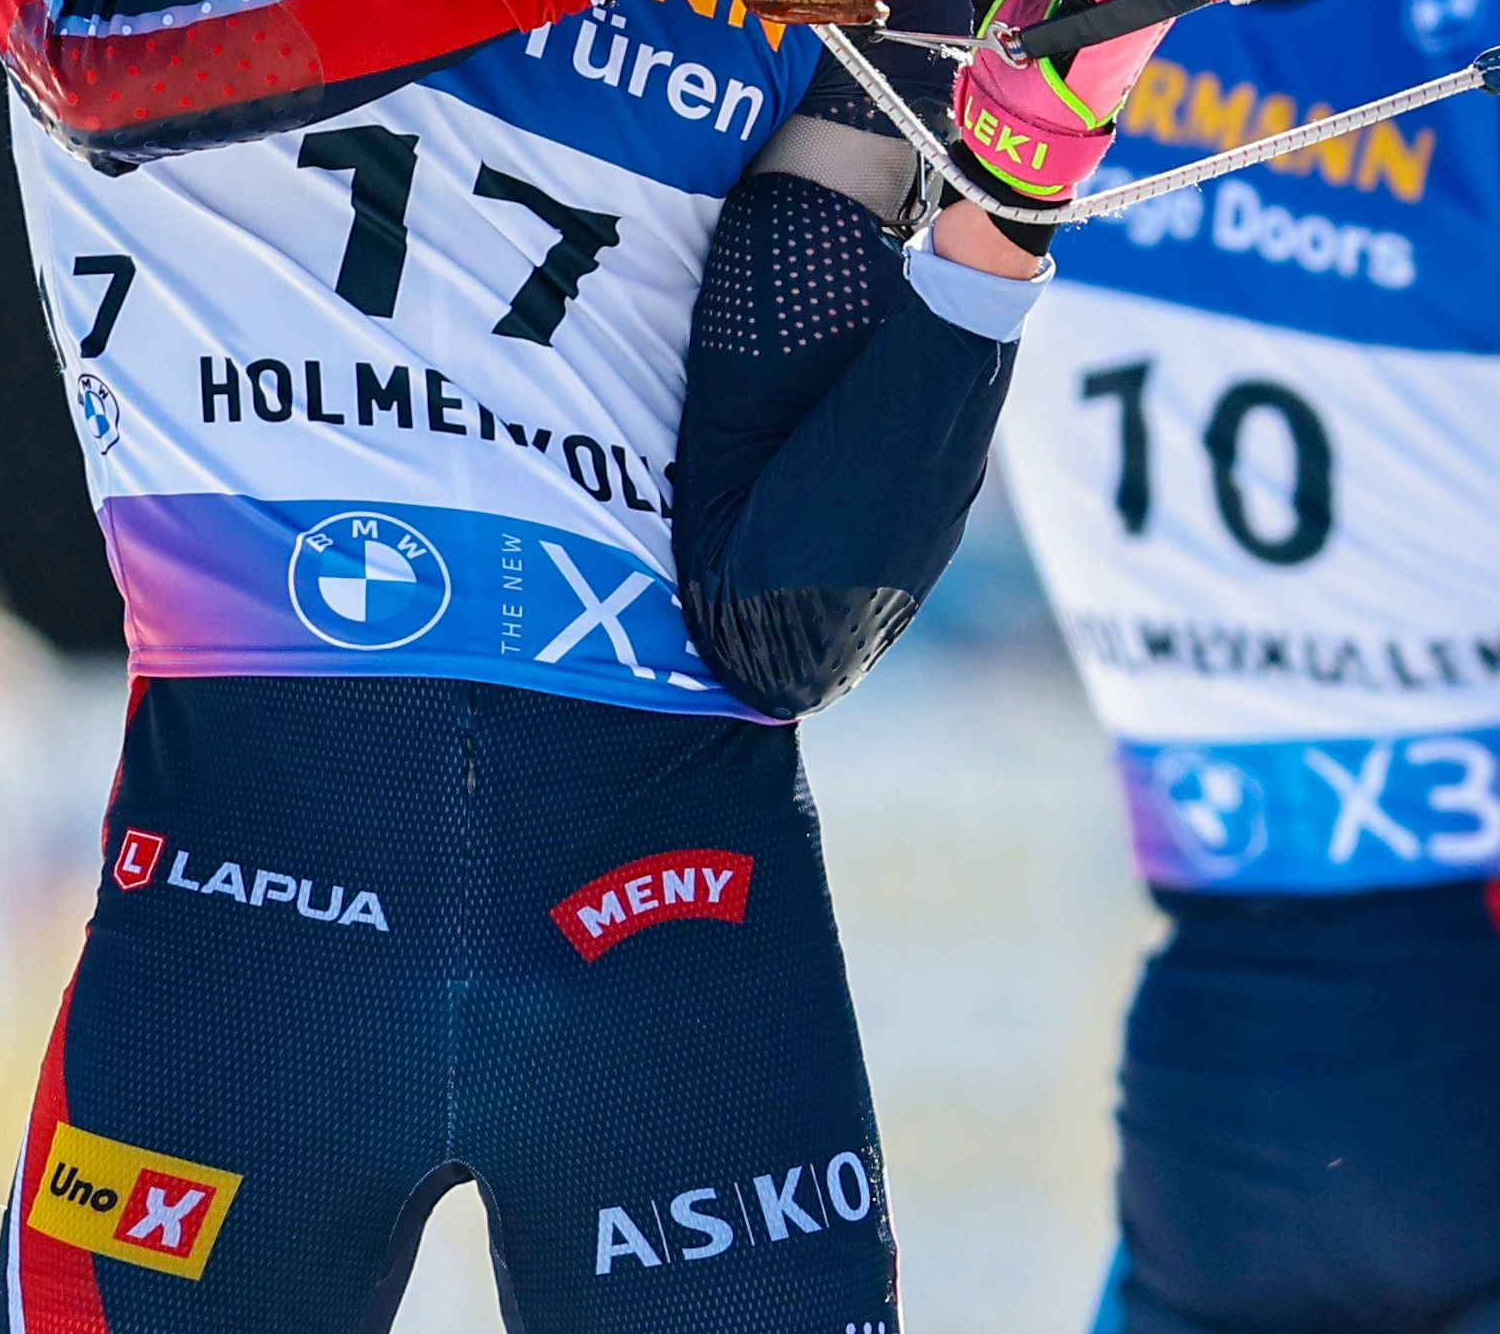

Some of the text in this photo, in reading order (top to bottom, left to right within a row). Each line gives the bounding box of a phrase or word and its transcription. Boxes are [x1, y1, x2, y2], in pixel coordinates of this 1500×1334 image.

[964, 95, 1048, 170] LEKI
[1122, 57, 1437, 205] RMANN
[296, 124, 622, 348] 17
[1213, 179, 1418, 290] Doors
[42, 254, 137, 367] 7
[1082, 357, 1335, 569] 10
[305, 519, 427, 561] BMW
[501, 533, 523, 654] THE NEW
[534, 539, 705, 691] X
[167, 849, 390, 933] LAPUA
[576, 866, 735, 940] MENY
[49, 1162, 206, 1251] Uno X
